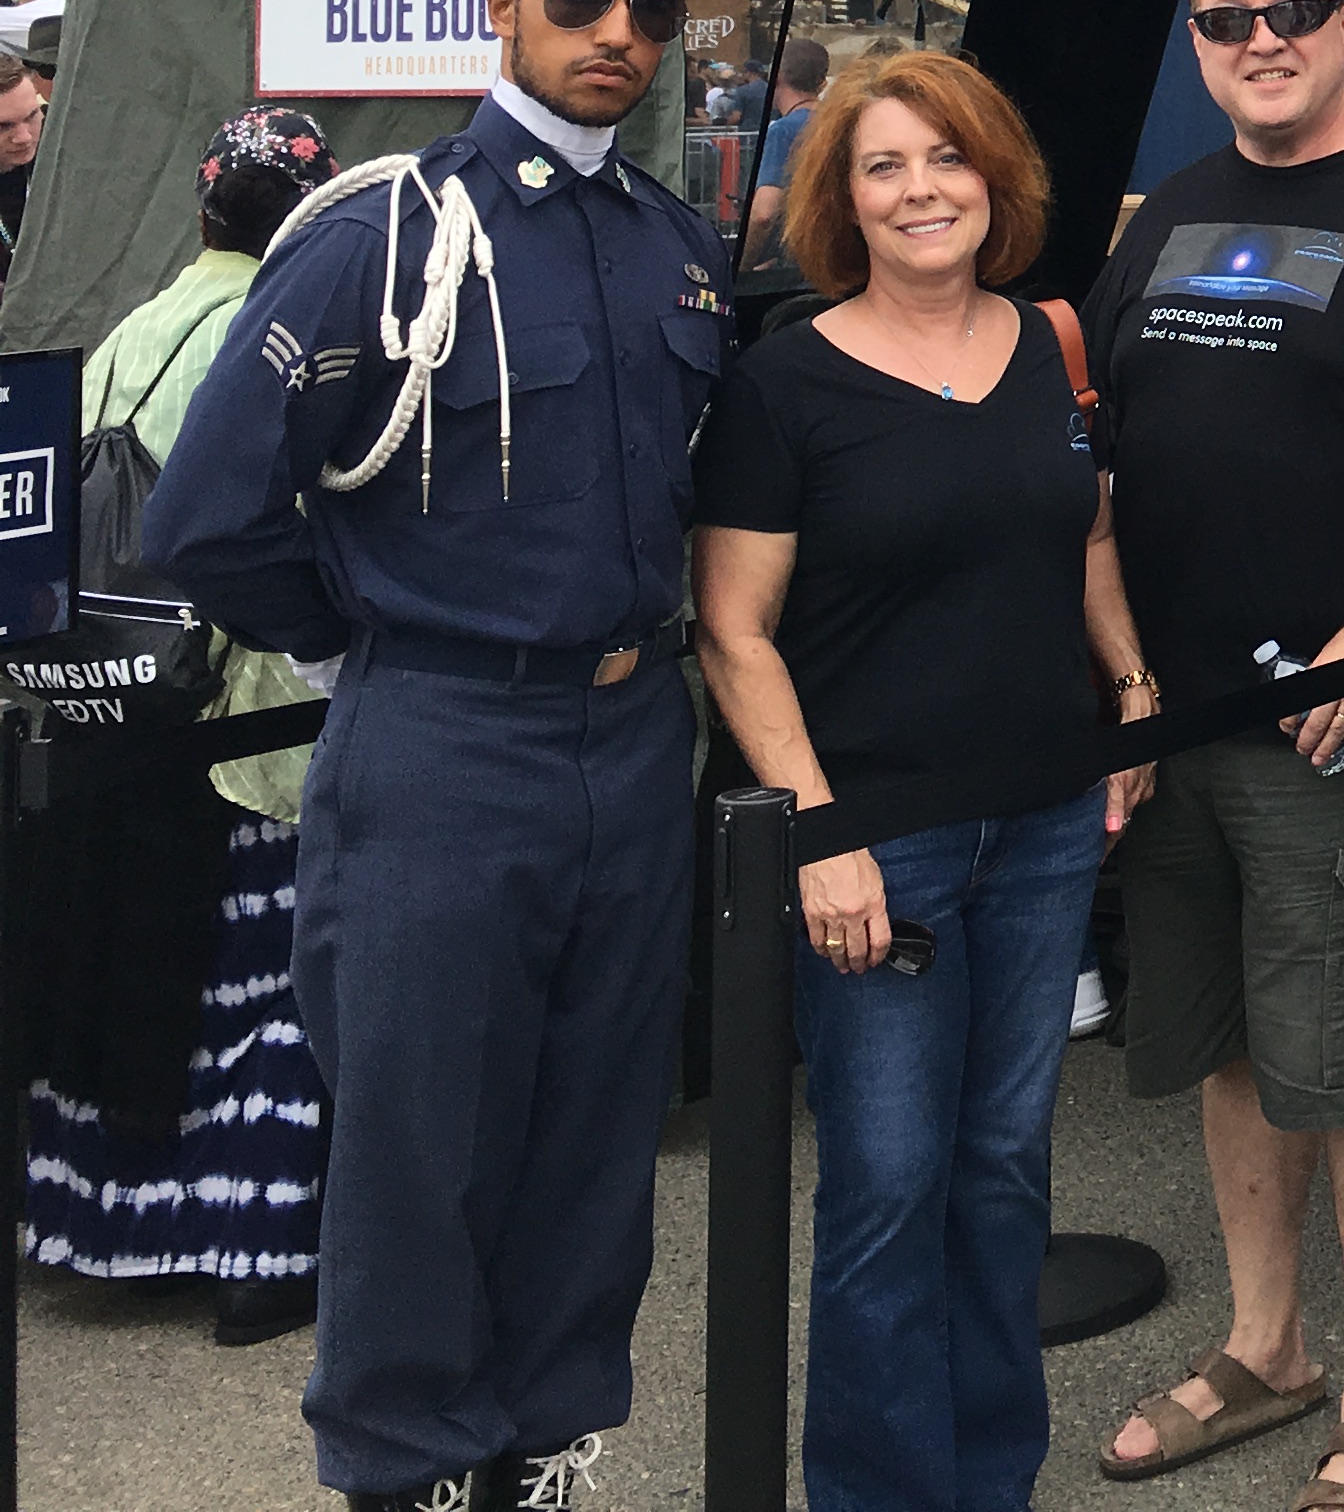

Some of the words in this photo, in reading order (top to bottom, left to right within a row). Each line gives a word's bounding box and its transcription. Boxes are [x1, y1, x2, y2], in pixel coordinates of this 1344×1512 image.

[365, 55, 488, 76] HEADQUARTERS
[1149, 306, 1283, 331] spacespeak.com
[1141, 326, 1166, 339] Send
[1168, 331, 1176, 340] a
[1178, 331, 1225, 348] message
[1226, 334, 1245, 348] into
[1247, 338, 1278, 352] space
[6, 654, 157, 689] SAMSUNG
